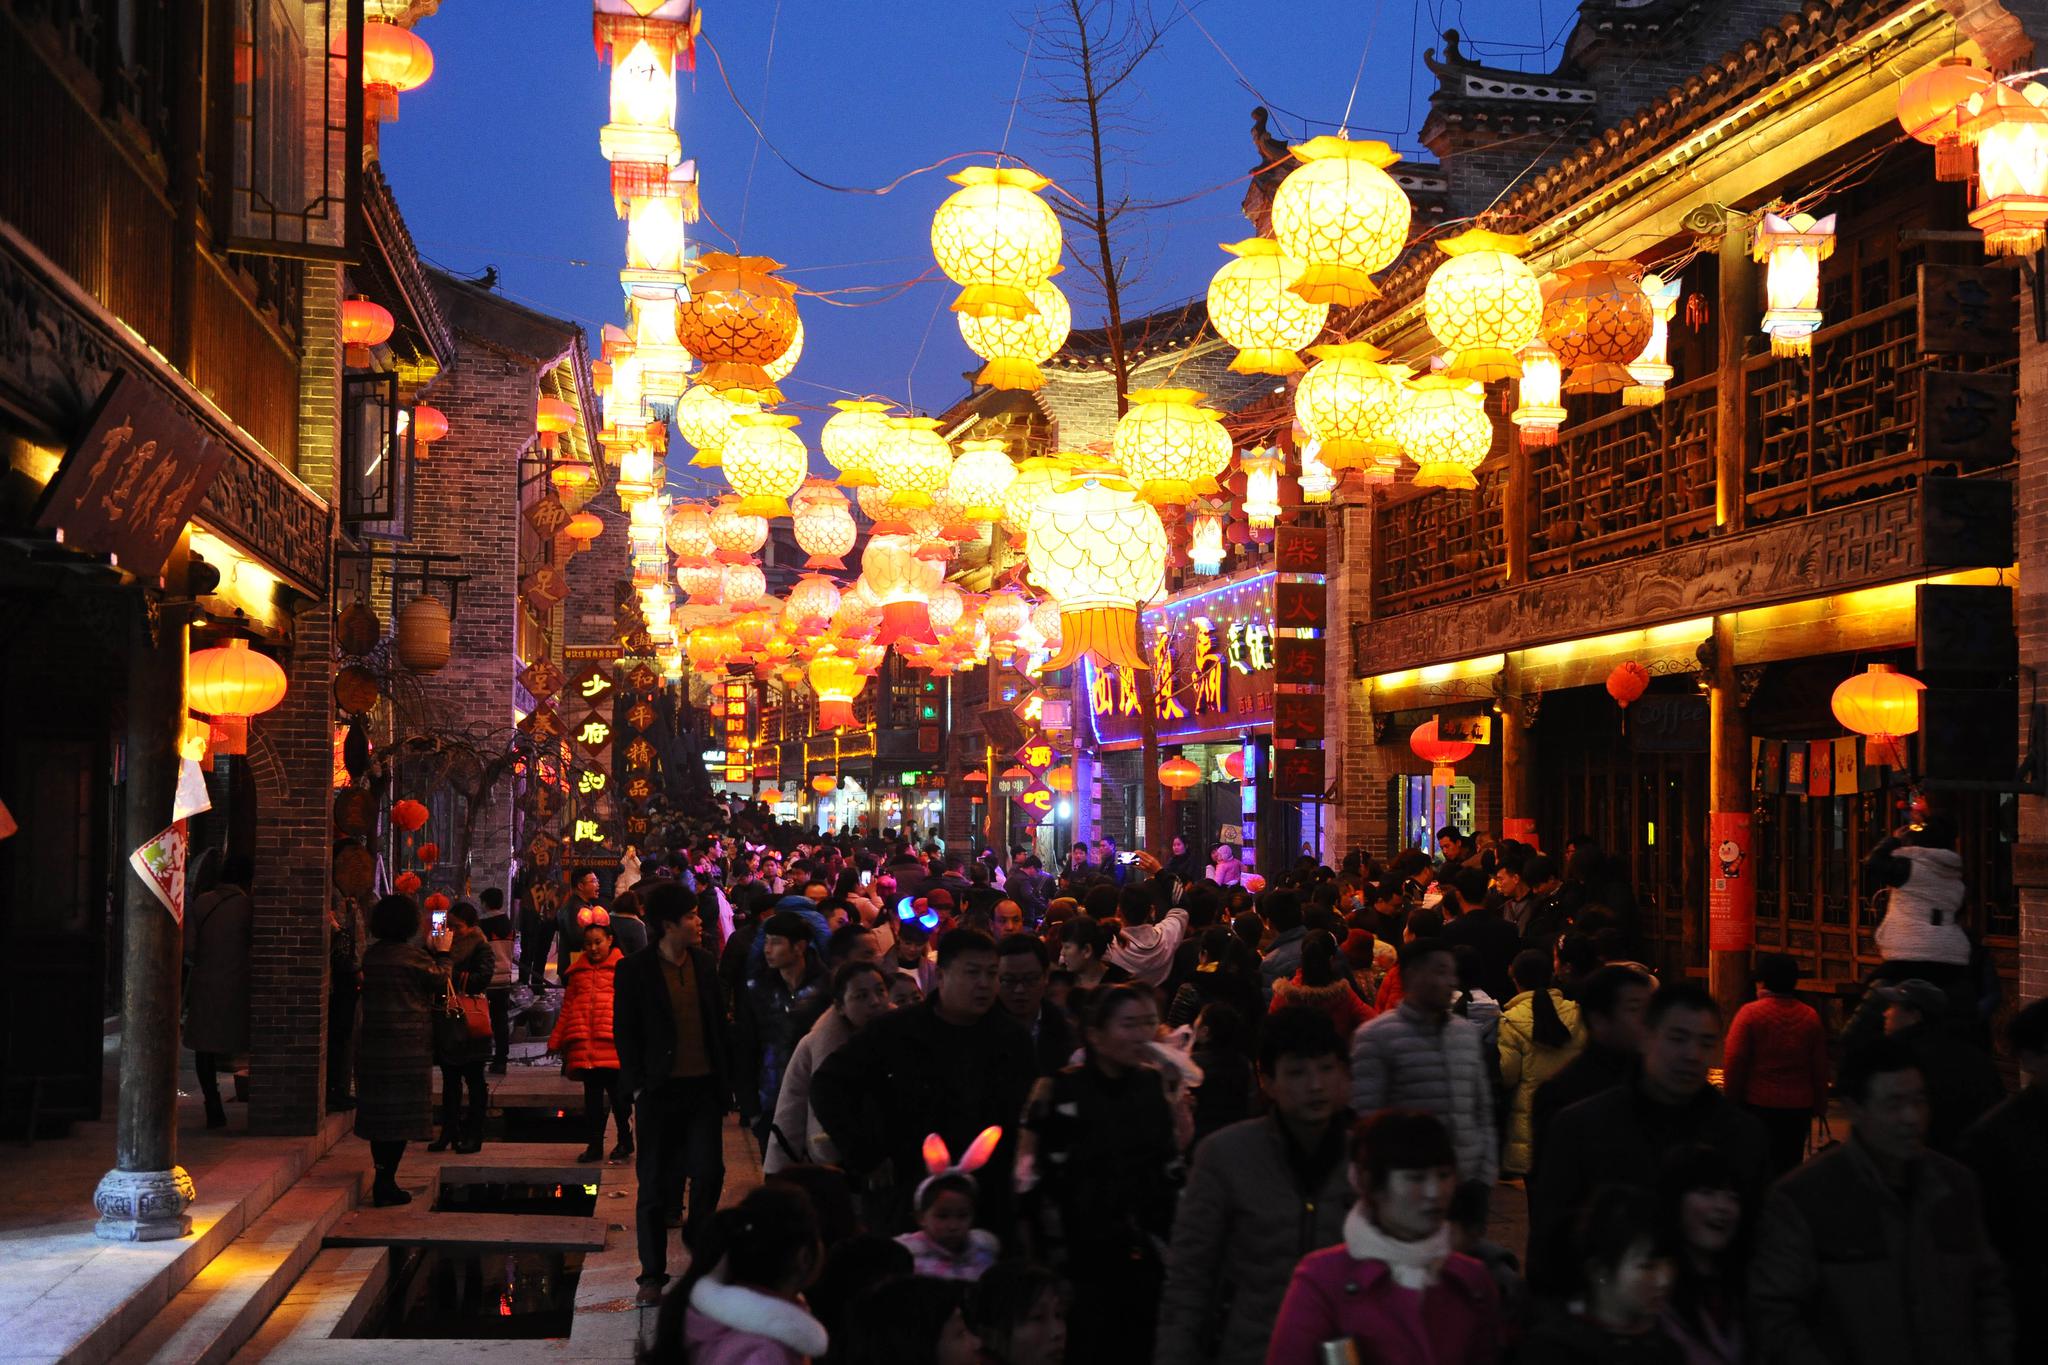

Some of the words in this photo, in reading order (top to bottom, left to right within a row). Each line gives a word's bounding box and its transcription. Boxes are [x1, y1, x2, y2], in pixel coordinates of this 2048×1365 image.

[1283, 536, 1319, 787] 柴火烤比萨
[998, 779, 1024, 792] 咖啡
